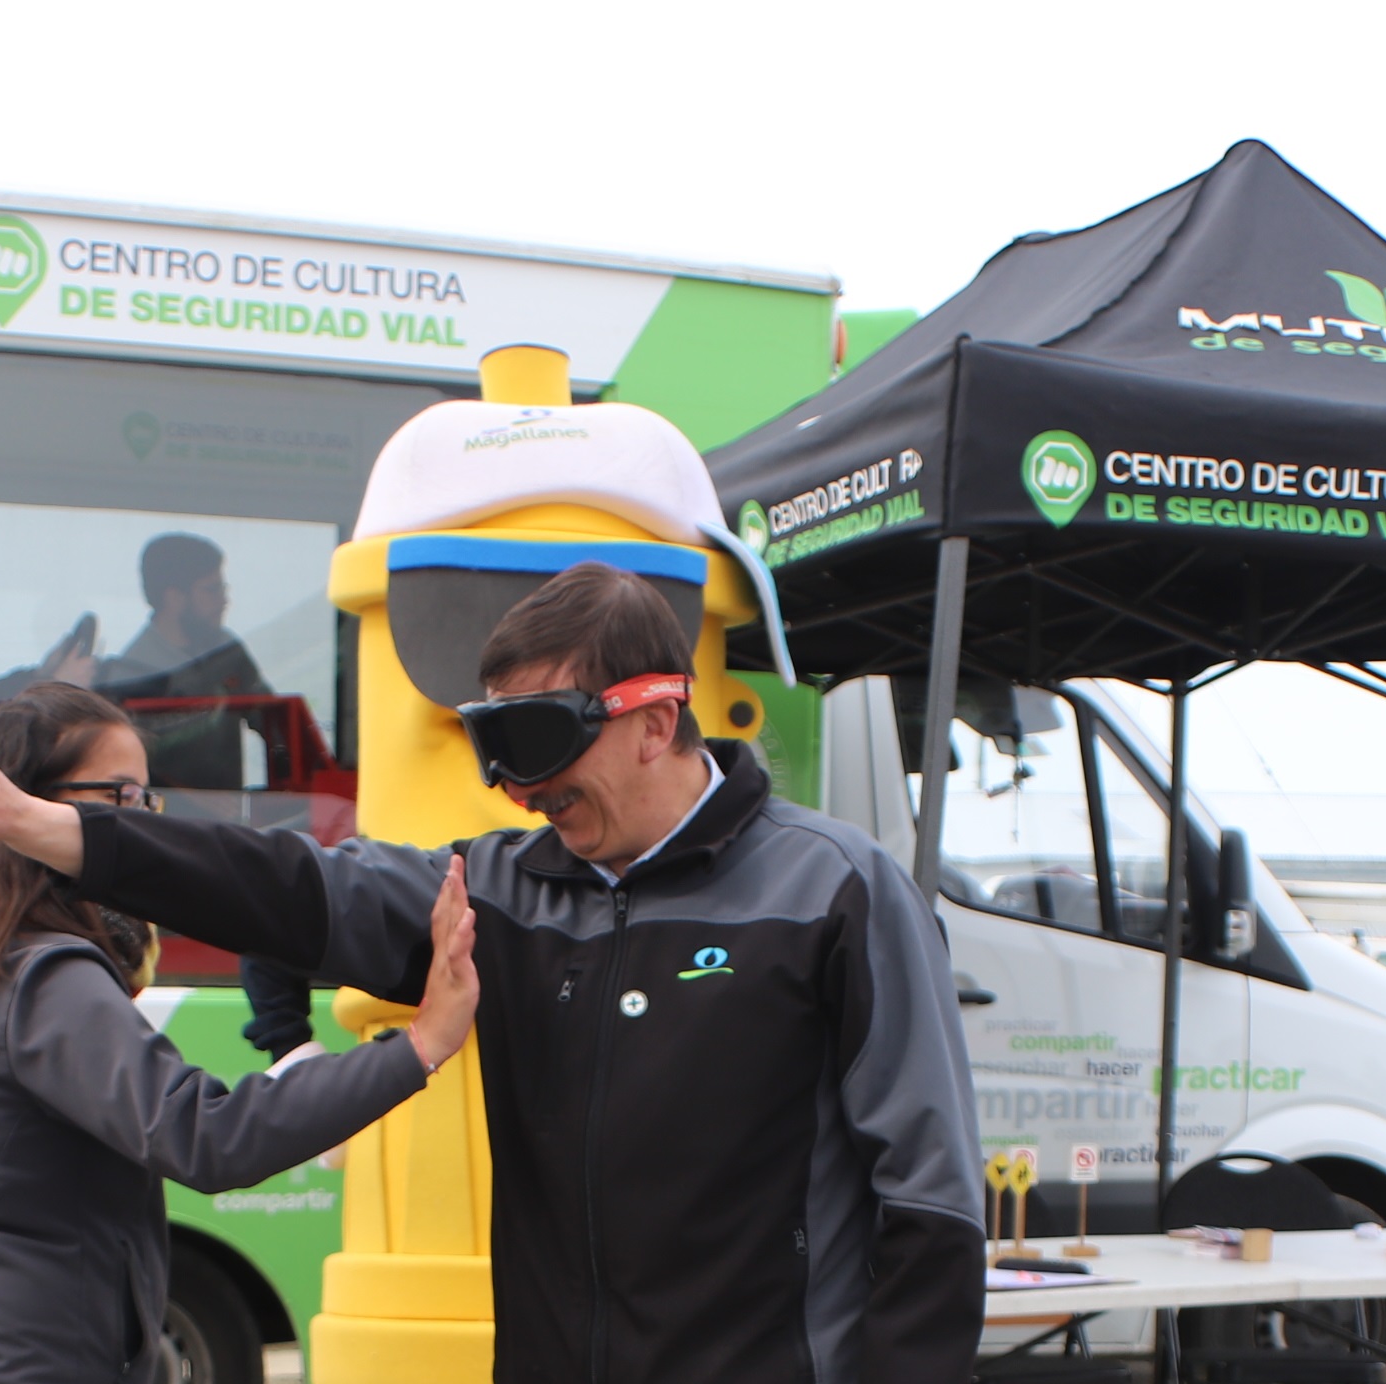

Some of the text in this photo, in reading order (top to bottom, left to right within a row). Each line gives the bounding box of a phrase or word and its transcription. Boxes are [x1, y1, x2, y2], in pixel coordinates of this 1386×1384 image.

[59, 238, 467, 304] CENTRO DE CULTURA
[59, 285, 467, 348] DE SEGURIDAD VIAL
[1189, 331, 1266, 352] de
[463, 427, 589, 452] Magallanes
[1104, 450, 1247, 491] CENTRO
[1251, 461, 1300, 496] DE
[767, 447, 925, 538] CENTRO DE CULTRA
[765, 488, 926, 569] DE SEGURIDAD VIAL
[1105, 492, 1160, 523] DE
[1164, 497, 1370, 539] SEGURIDAD
[984, 1016, 1058, 1034] practicar
[1008, 1031, 1119, 1054] compartir
[1085, 1057, 1143, 1078] hacer
[975, 1082, 1148, 1129] mpartir
[1144, 1100, 1199, 1119] her
[213, 1187, 337, 1217] compartir
